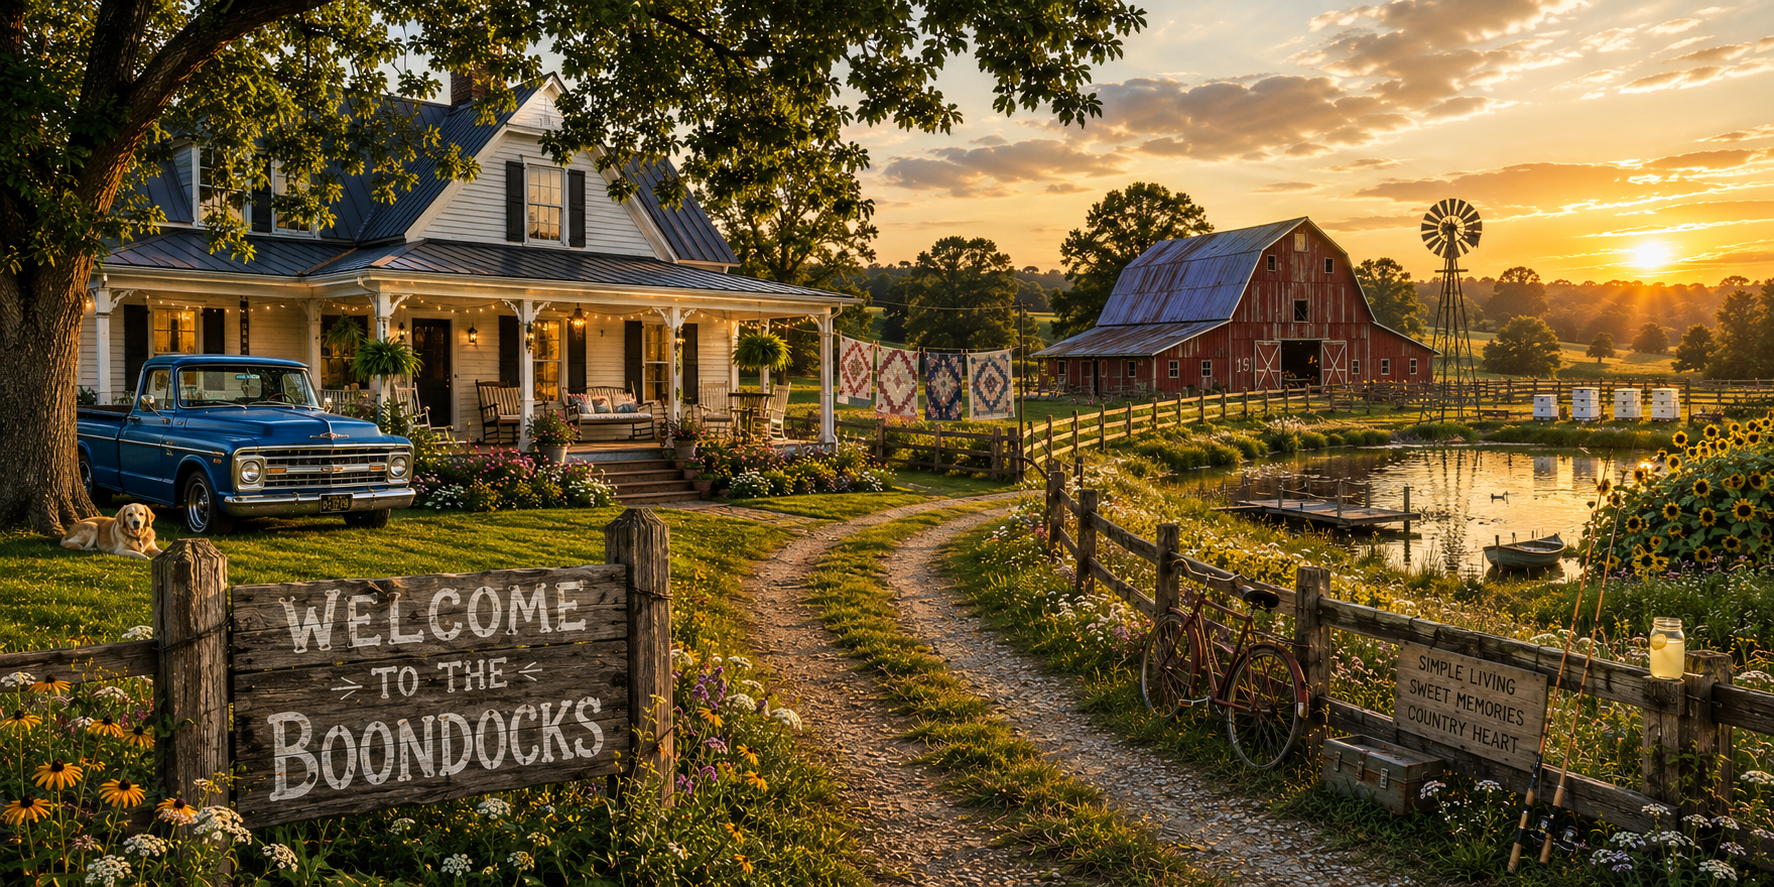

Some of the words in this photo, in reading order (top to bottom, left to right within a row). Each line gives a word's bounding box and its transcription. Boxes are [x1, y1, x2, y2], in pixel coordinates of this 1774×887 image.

[278, 579, 587, 653] WELCOME
[370, 665, 419, 699] TO
[437, 656, 508, 694] THE
[1418, 655, 1464, 681] SIMPLE
[1469, 667, 1516, 695] LIVING
[1409, 679, 1451, 704] SWEET
[1456, 692, 1525, 726] MEMORIES
[266, 696, 605, 802] BOONDOCKS
[1407, 705, 1467, 737] COUNTRY
[1472, 724, 1519, 754] HEART
